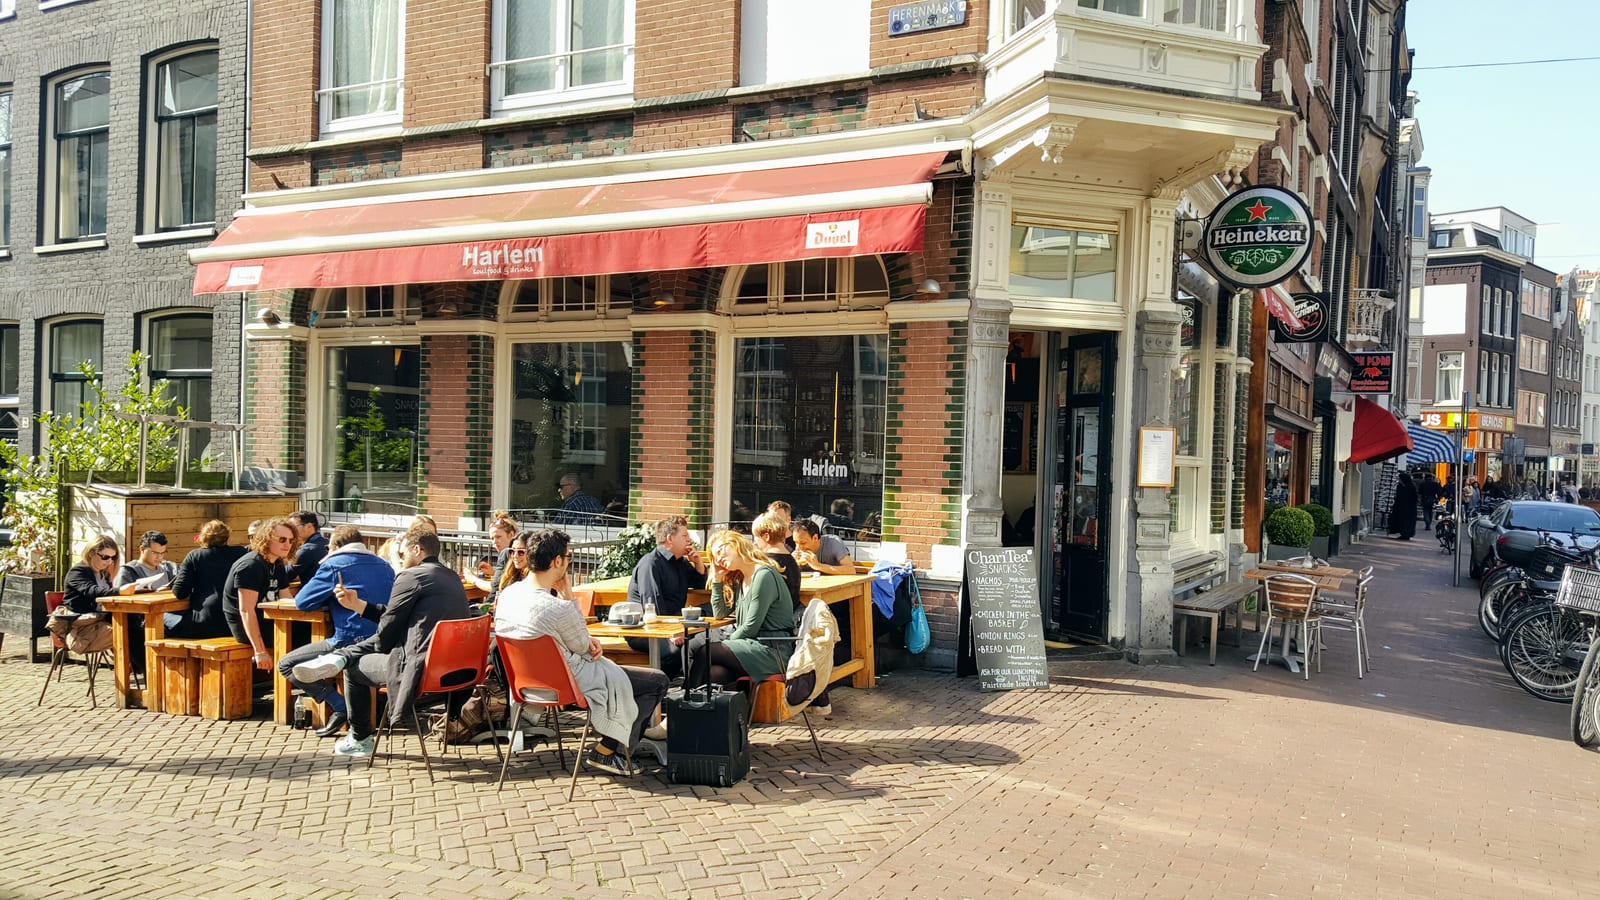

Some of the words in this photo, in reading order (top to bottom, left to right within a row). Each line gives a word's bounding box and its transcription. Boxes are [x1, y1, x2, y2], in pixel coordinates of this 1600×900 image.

[814, 229, 851, 245] Duvel
[1214, 226, 1306, 245] Heineken
[462, 243, 543, 266] Harlem
[472, 266, 502, 277] soulfood
[510, 265, 534, 273] drinks
[802, 458, 848, 478] Harlem
[968, 549, 1030, 564] ChariTea
[988, 564, 1018, 574] SNACKS
[975, 577, 1003, 585] NACHOS
[977, 611, 1005, 619] CHICKEN
[988, 619, 1016, 628] BASKET
[980, 632, 1002, 640] ONION
[1003, 632, 1026, 640] RINGS
[980, 645, 1003, 654] BREAD
[1006, 645, 1026, 654] WITH
[982, 681, 1014, 689] Fairtrade
